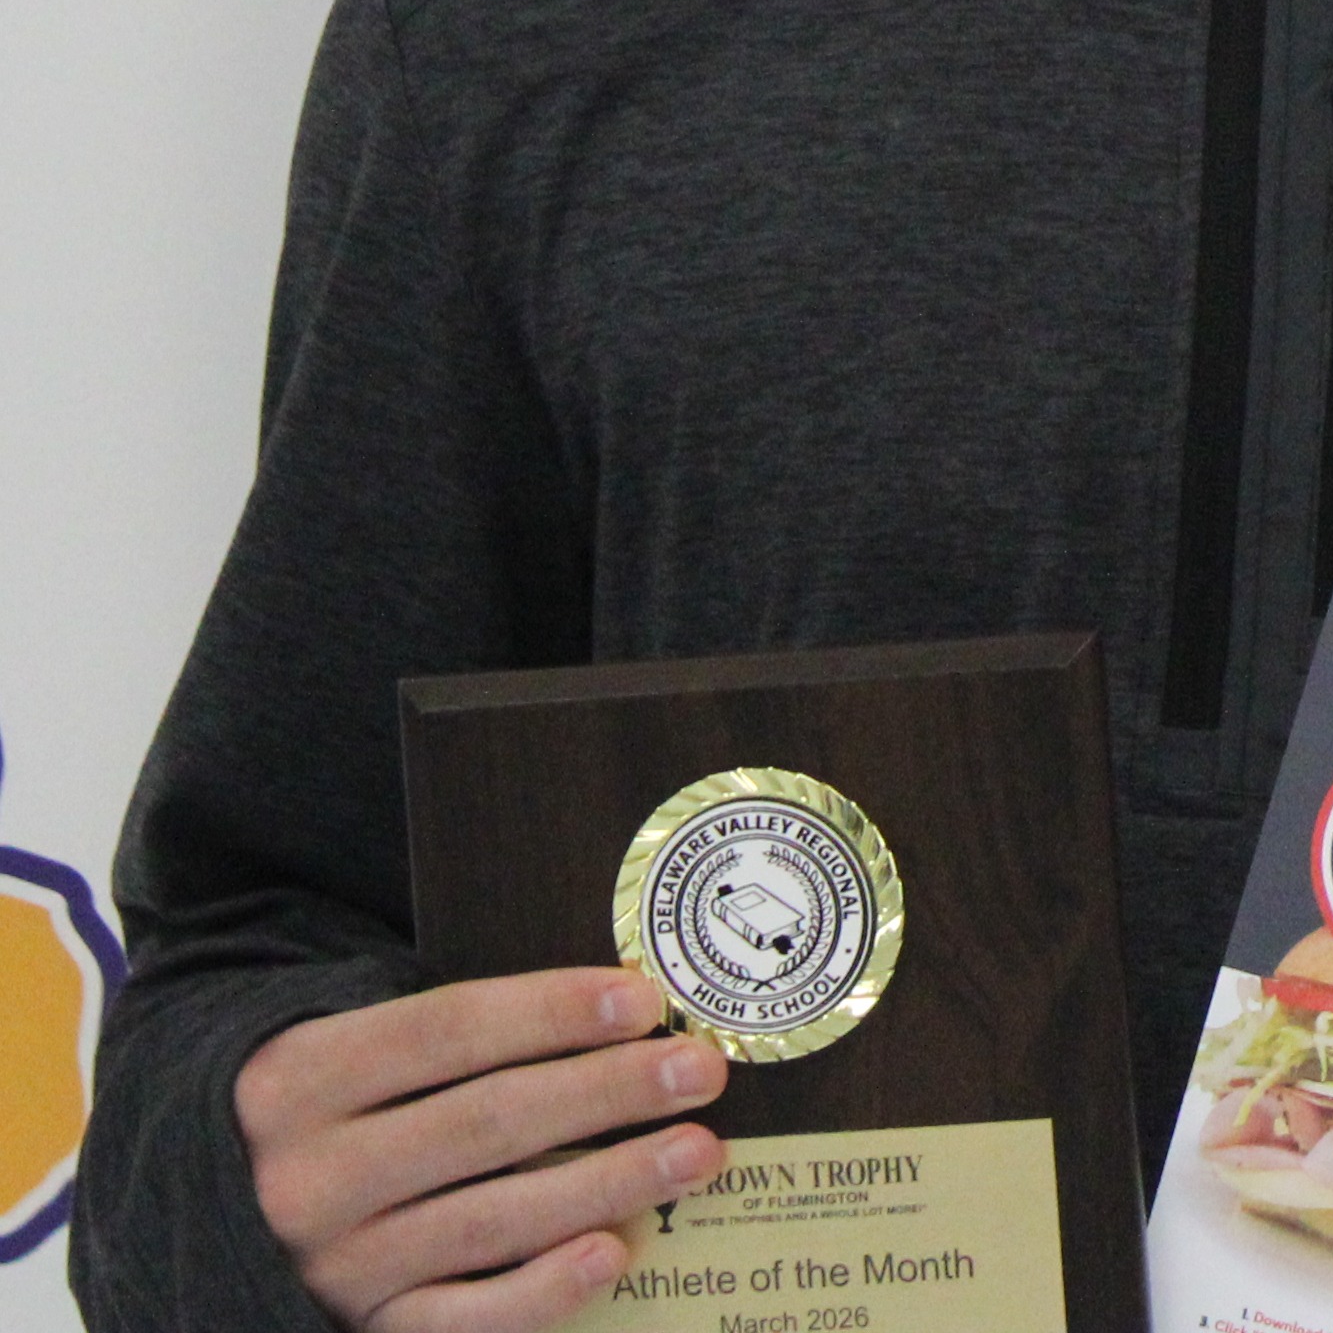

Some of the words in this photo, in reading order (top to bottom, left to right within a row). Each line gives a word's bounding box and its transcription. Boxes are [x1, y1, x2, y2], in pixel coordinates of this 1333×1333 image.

[657, 830, 715, 934] DELAWARE
[714, 815, 794, 837] VALLEY
[796, 826, 860, 920] REGIONAL
[692, 984, 746, 1018] HIGH
[756, 972, 842, 1021] SCHOOL
[688, 1161, 796, 1197] ROWN
[807, 1154, 923, 1189] TROPHY
[742, 1197, 764, 1211] OF
[768, 1191, 870, 1209] FLEMINGTON
[613, 1266, 737, 1301] Athlete
[749, 1259, 785, 1294] of
[796, 1258, 850, 1290] the
[863, 1247, 976, 1287] Month
[719, 1310, 798, 1333] March
[807, 1306, 870, 1331] 2026
